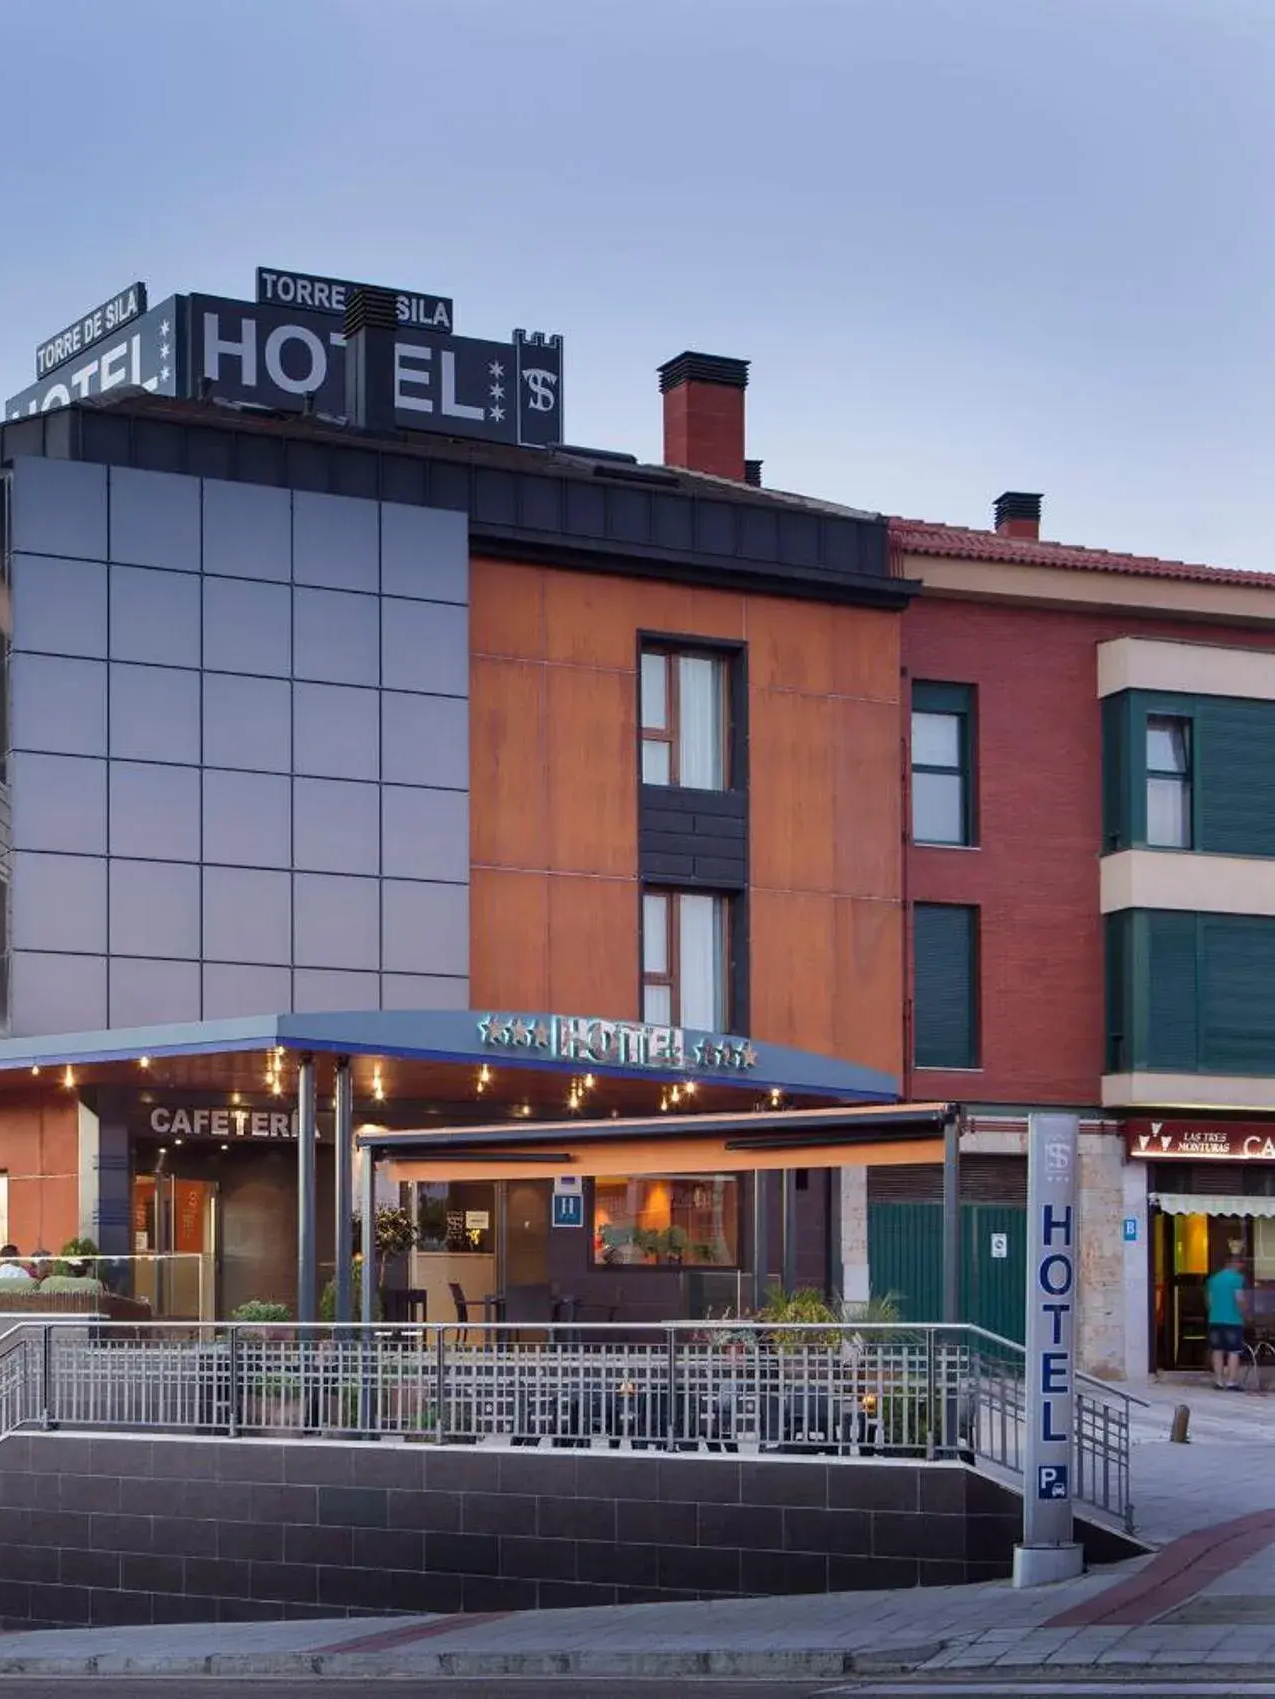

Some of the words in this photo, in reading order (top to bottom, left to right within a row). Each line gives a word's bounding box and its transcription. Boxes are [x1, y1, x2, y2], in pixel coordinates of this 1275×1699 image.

[262, 272, 347, 312] TORRE
[395, 295, 451, 328] SILA
[37, 327, 81, 373] TORRE
[84, 312, 102, 344] DE
[105, 289, 138, 329] SILA
[11, 332, 158, 420] TEL
[203, 311, 486, 422] HOEL
[551, 1014, 685, 1070] HOTEL
[150, 1106, 322, 1138] CAFETERÍ
[1177, 1142, 1230, 1152] MONTURAS
[1184, 1132, 1202, 1141] LAS
[1205, 1132, 1227, 1142] TRES
[1039, 1204, 1073, 1442] HOTEL
[1040, 1467, 1058, 1489] P
